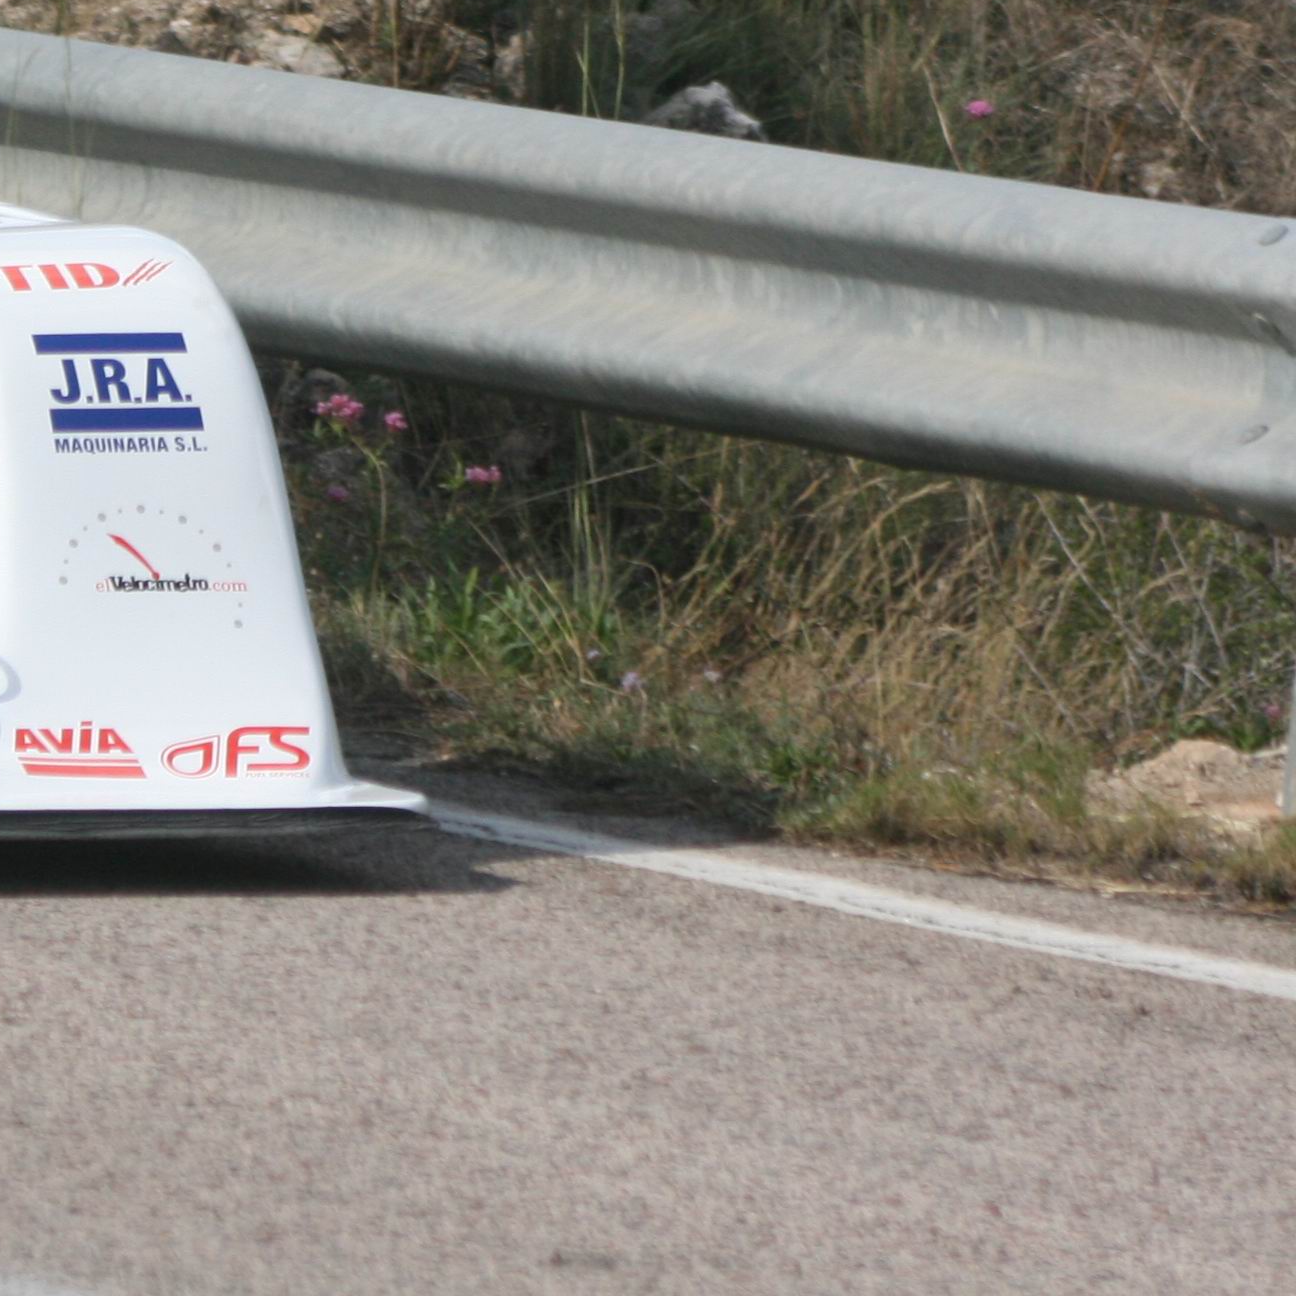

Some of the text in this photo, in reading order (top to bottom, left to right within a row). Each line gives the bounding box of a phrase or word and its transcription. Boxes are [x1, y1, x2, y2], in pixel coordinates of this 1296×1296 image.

[50, 357, 192, 405] J.R.A.
[54, 436, 209, 454] MAQUINARIA S.L.
